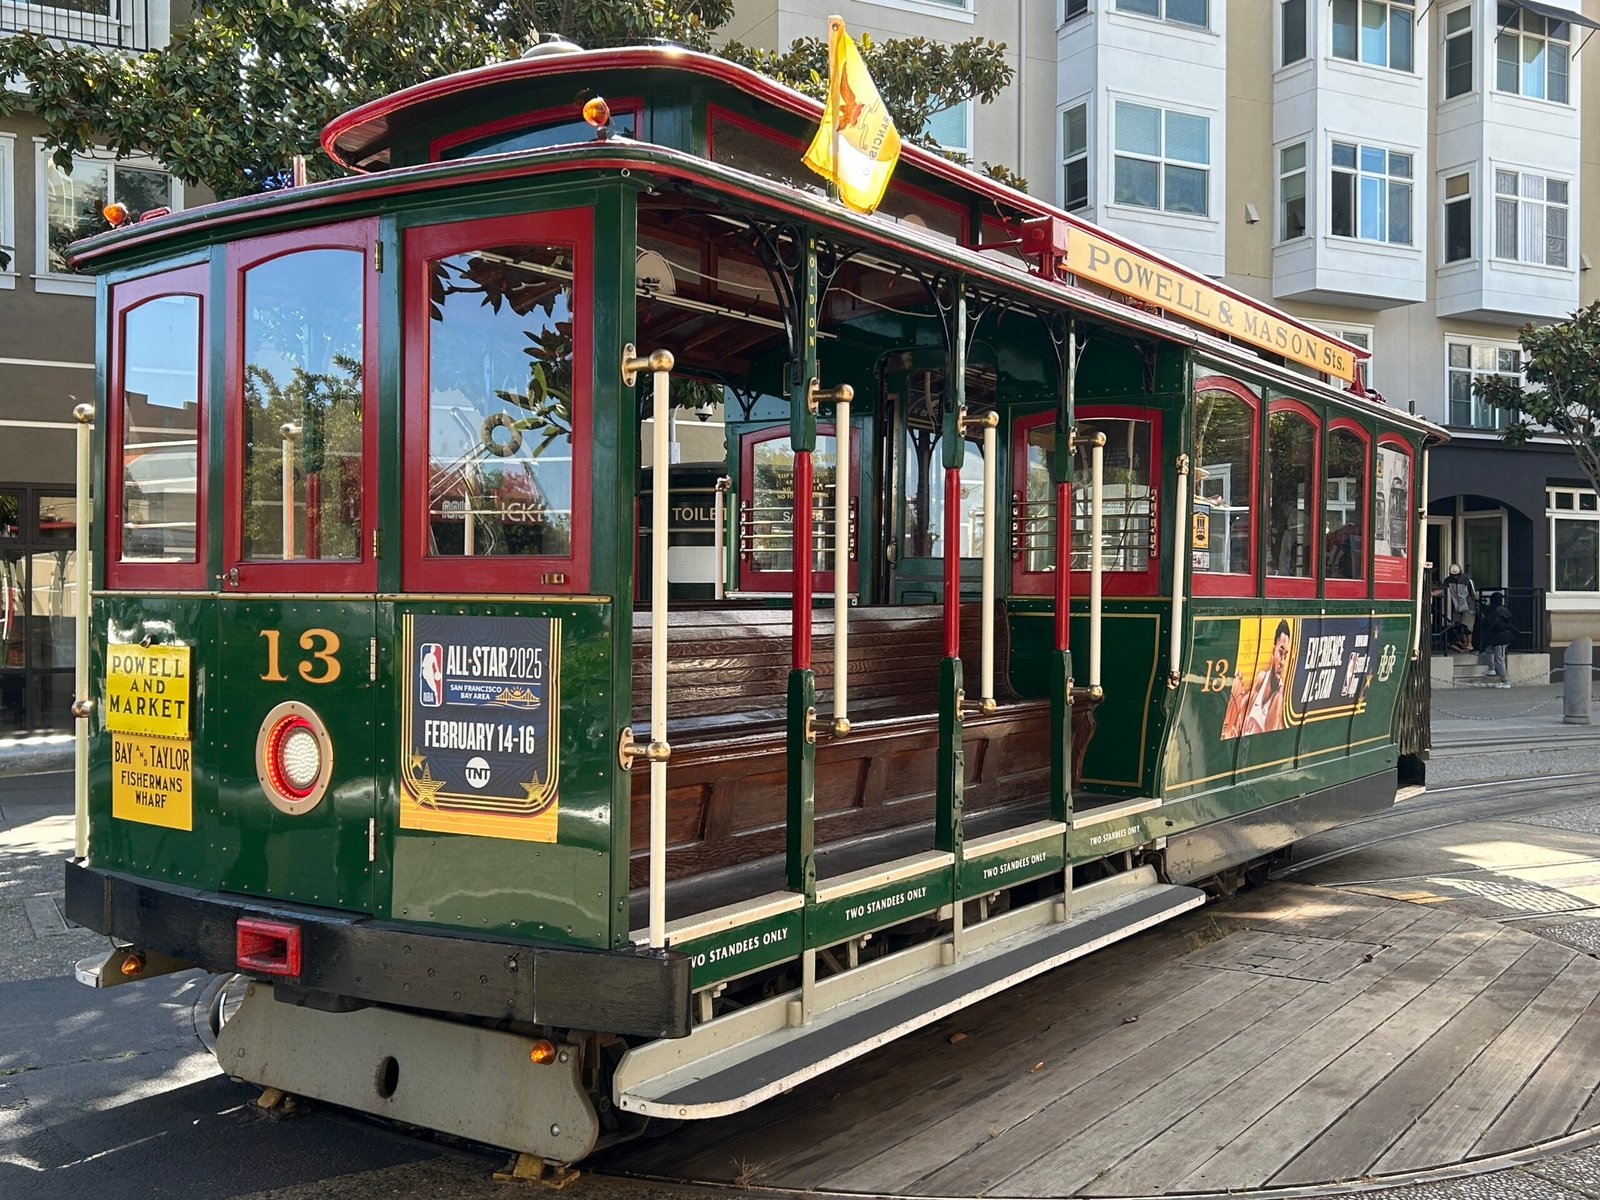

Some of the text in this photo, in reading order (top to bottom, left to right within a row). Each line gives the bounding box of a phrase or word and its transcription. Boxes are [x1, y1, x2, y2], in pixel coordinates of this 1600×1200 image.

[1087, 243, 1345, 372] POWELL & MASON Sts.
[809, 317, 815, 346] ON
[111, 655, 185, 678] POWELL
[259, 628, 341, 684] 13
[509, 647, 543, 680] 2025
[129, 679, 165, 694] AND
[450, 683, 502, 694] SAN FRANCISCO
[1201, 658, 1229, 693] 13
[109, 694, 185, 719] MARKET
[460, 692, 491, 700] BAY AREA
[424, 719, 535, 755] FEBRUARY 14-16
[115, 741, 190, 772] BAY AND TAYLOR
[120, 770, 183, 793] FISHERMANS
[466, 766, 491, 782] TNT
[135, 793, 167, 809] WHARF
[1090, 824, 1140, 846] TWO STANDEES ONLY
[983, 851, 1046, 879] TWO STANDEES ONLY
[845, 886, 927, 921] TWO STANDEES ONLY
[690, 927, 788, 969] WO STANDEES ONLY
